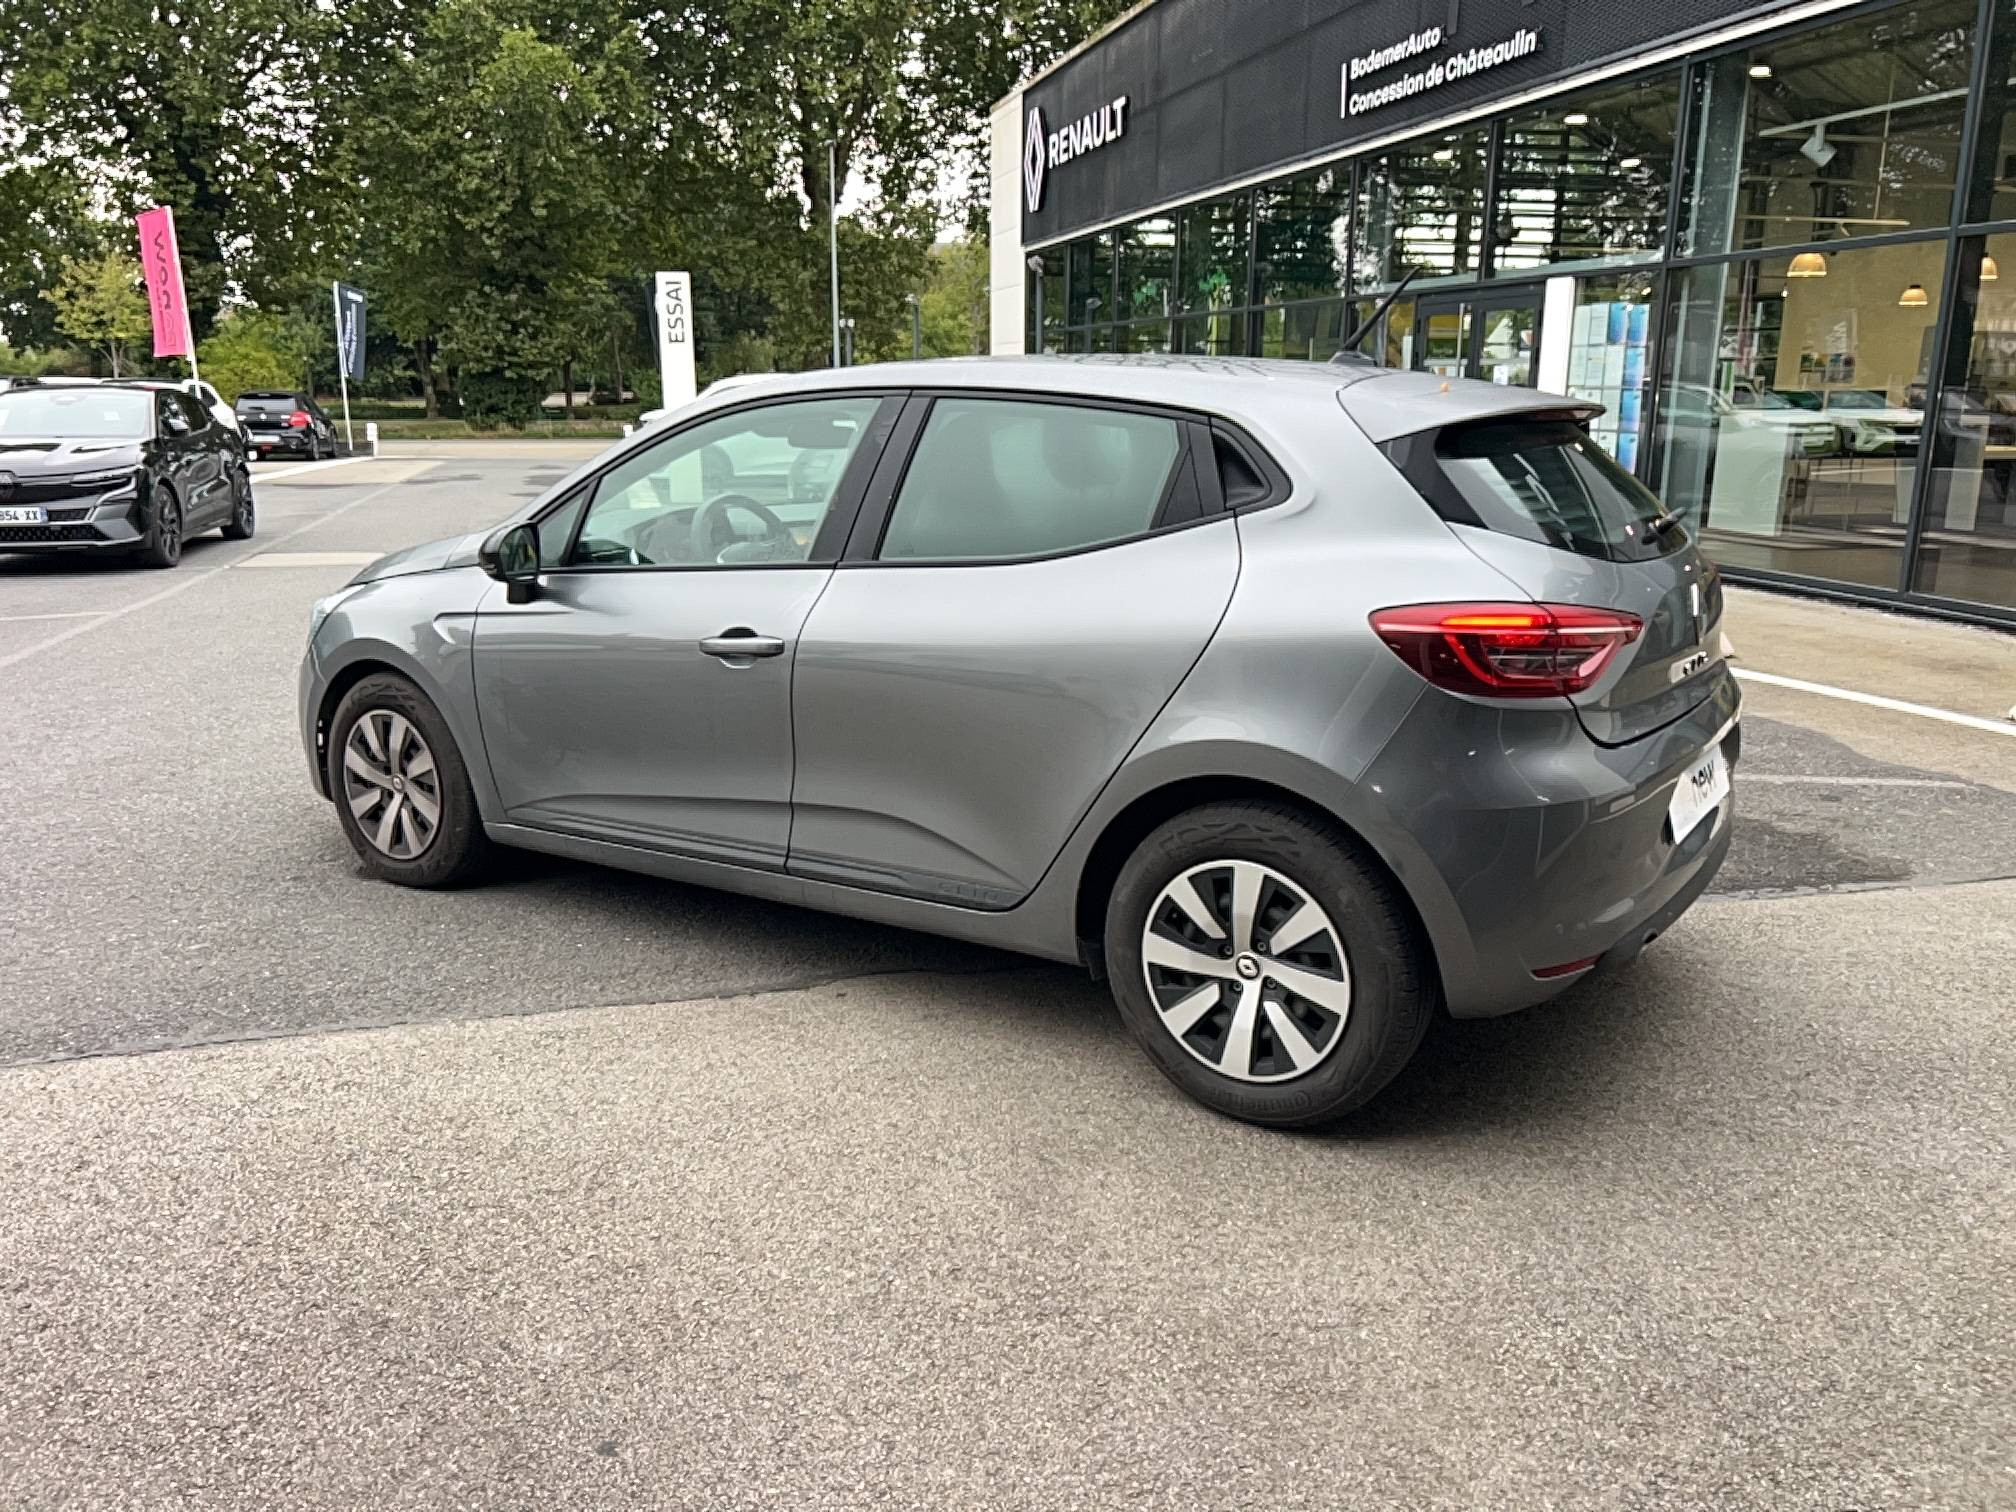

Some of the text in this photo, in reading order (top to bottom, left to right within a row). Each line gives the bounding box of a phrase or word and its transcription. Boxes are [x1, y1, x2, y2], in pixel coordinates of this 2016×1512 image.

[1349, 28, 1537, 116] Concession de Châteaulin
[1350, 27, 1441, 80] BodemerAuto
[1048, 95, 1126, 169] RENAULT
[665, 280, 685, 344] ESSAI
